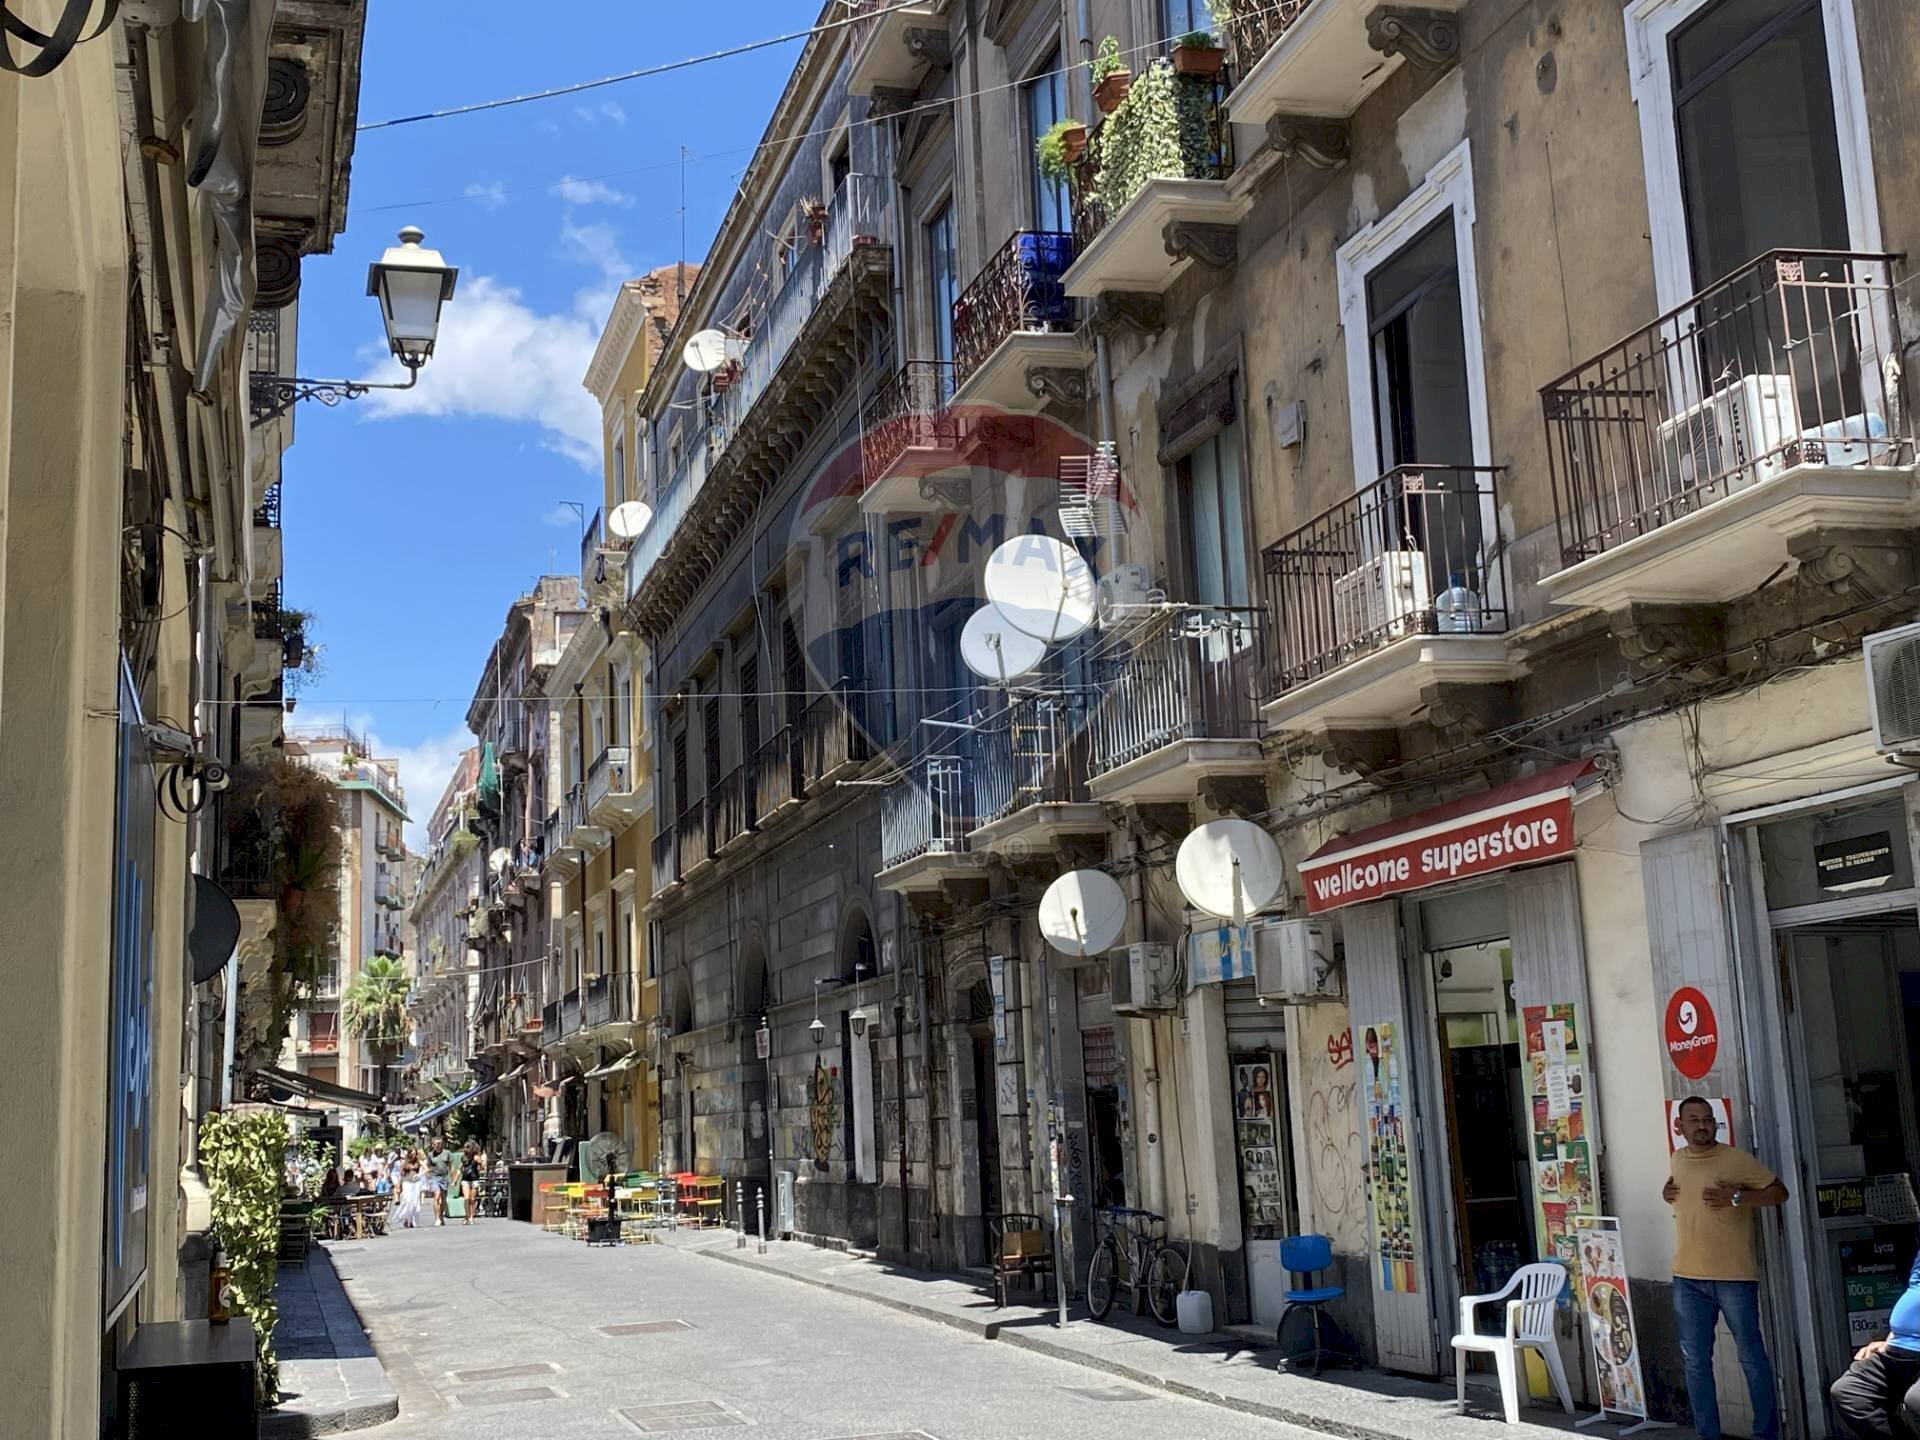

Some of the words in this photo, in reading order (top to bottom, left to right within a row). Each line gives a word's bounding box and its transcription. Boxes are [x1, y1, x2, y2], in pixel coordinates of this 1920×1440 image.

[1313, 857, 1409, 900] wellcome
[1421, 818, 1558, 874] superstore
[1874, 1243, 1894, 1254] Lyca
